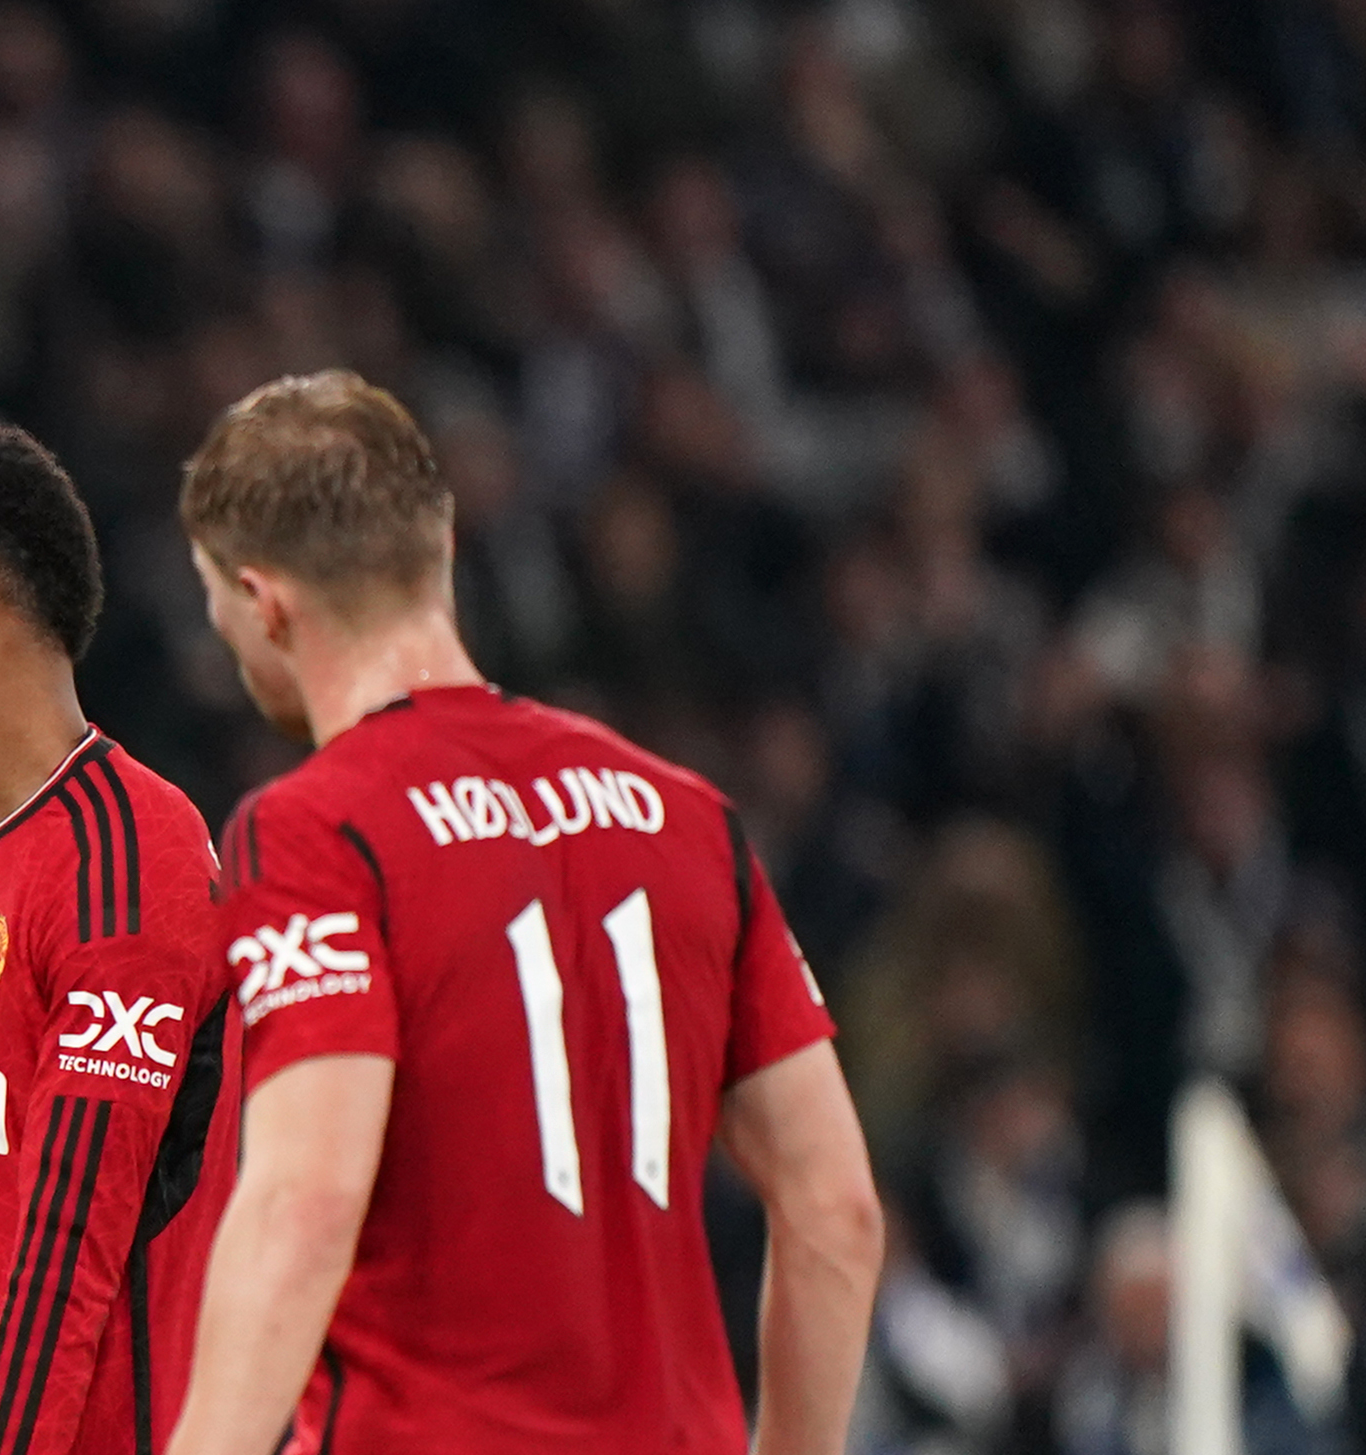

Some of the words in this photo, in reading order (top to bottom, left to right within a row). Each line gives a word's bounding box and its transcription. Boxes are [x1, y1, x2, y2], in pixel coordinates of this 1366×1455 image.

[227, 912, 370, 1006] DXC
[59, 991, 184, 1067] DXC
[506, 887, 670, 1217] 11
[59, 1054, 171, 1090] TECHNOLOGY
